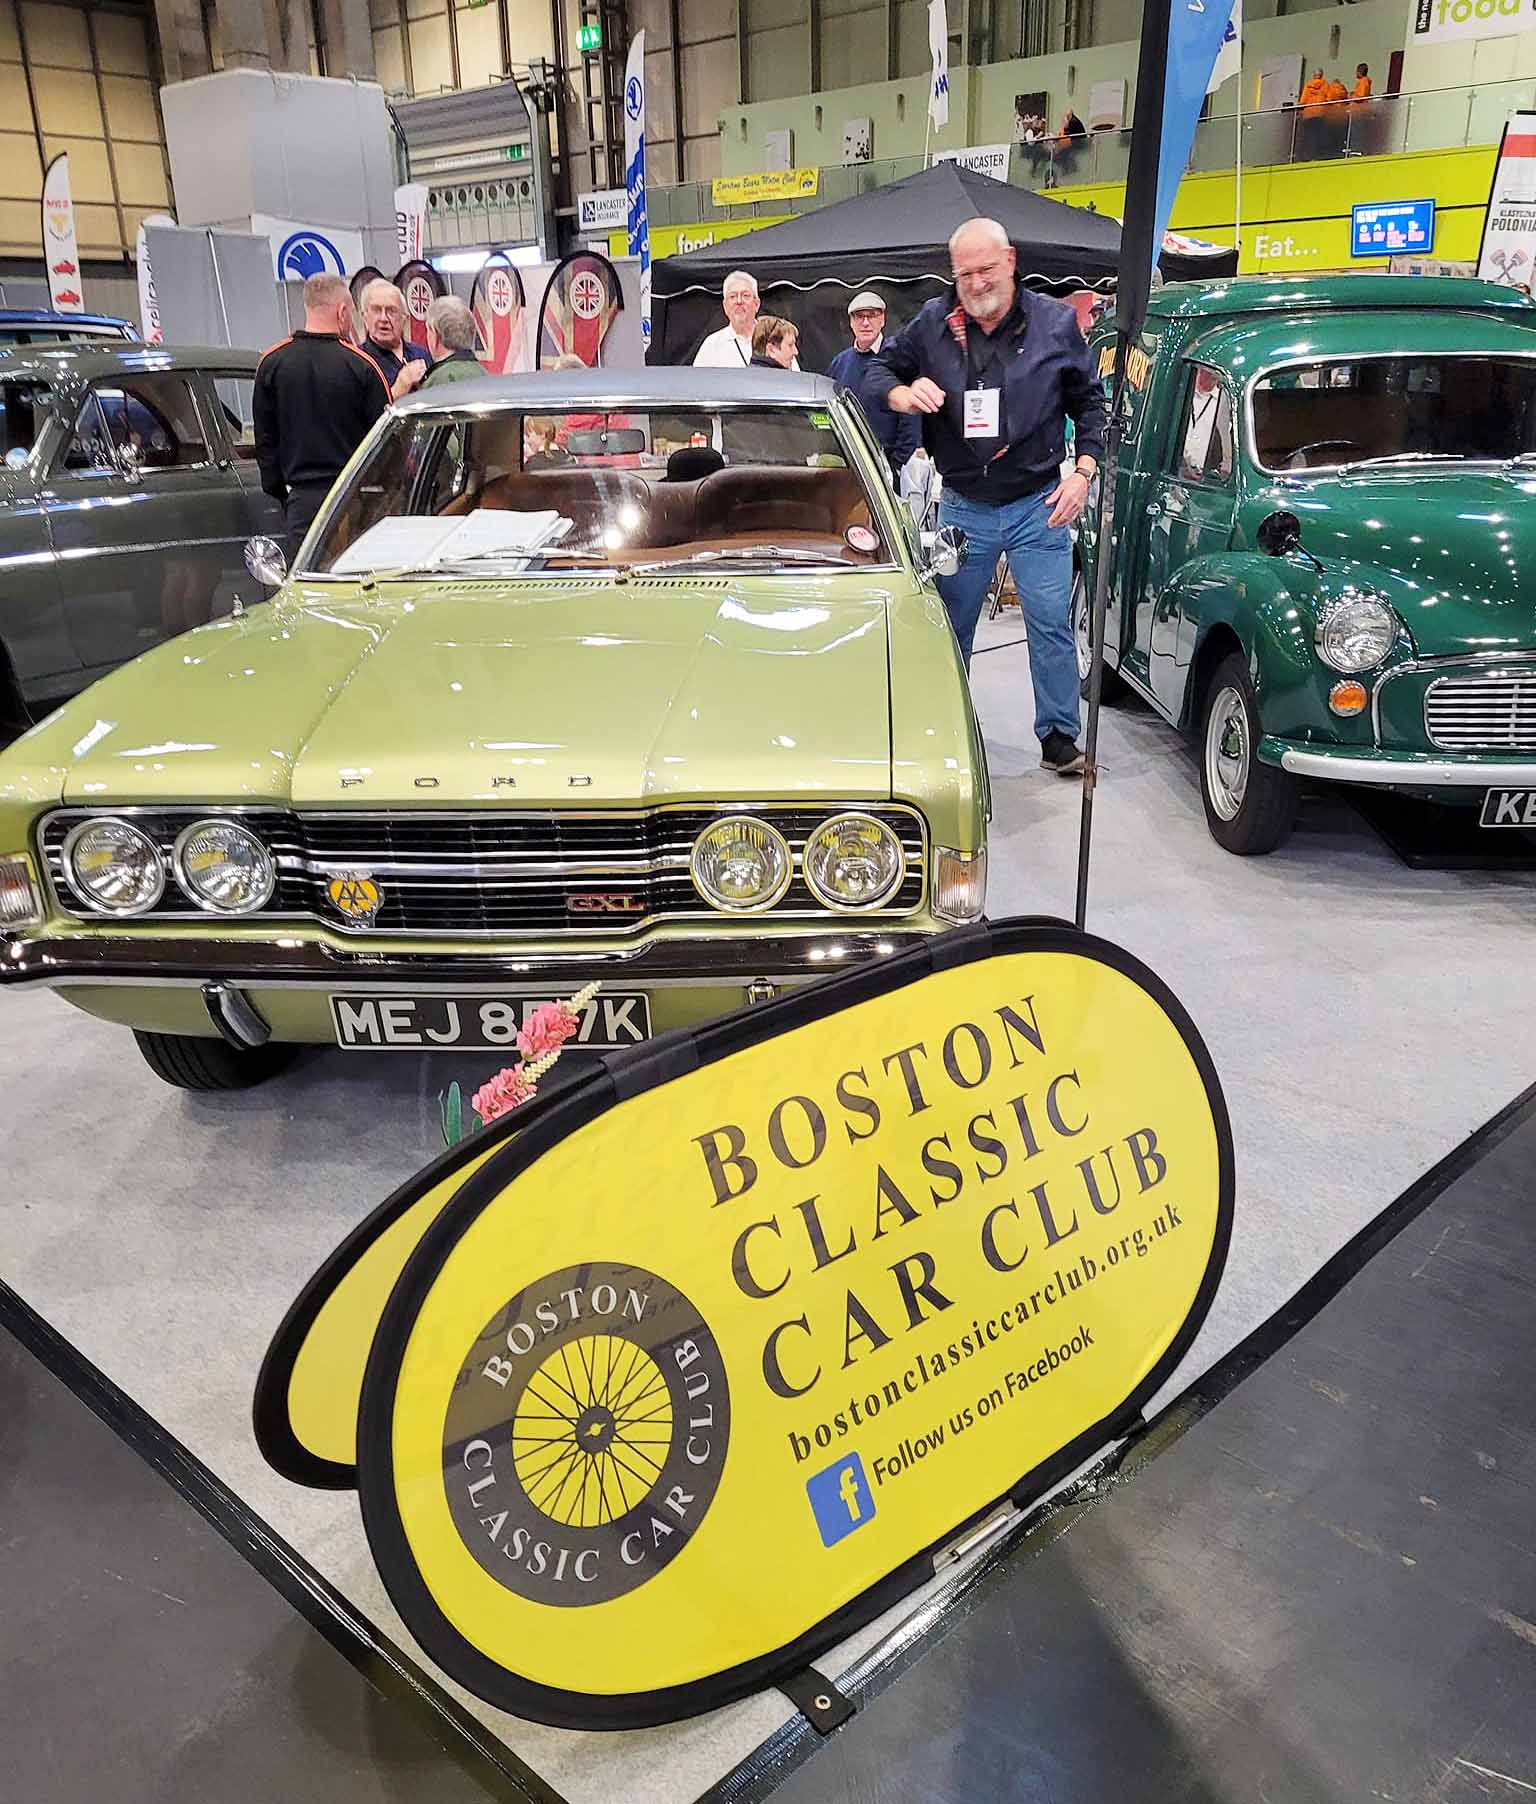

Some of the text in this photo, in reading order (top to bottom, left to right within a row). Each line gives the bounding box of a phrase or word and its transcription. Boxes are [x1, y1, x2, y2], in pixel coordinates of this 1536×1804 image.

[960, 153, 1005, 169] ANCASTER
[141, 240, 161, 329] celica-clu
[567, 895, 645, 911] GXL
[337, 1000, 644, 1044] MEJ 87K
[690, 995, 1047, 1208] BOSTON
[731, 1068, 1090, 1299] CLASSIC
[762, 1127, 1168, 1399] CAR CLUB
[481, 1284, 649, 1388] BOSTON
[787, 1203, 1183, 1464] bostonclassiccarclub.org.uk
[872, 1324, 1096, 1486] Follow us on Facebook
[462, 1338, 714, 1583] CLASSIC CAR CLUB
